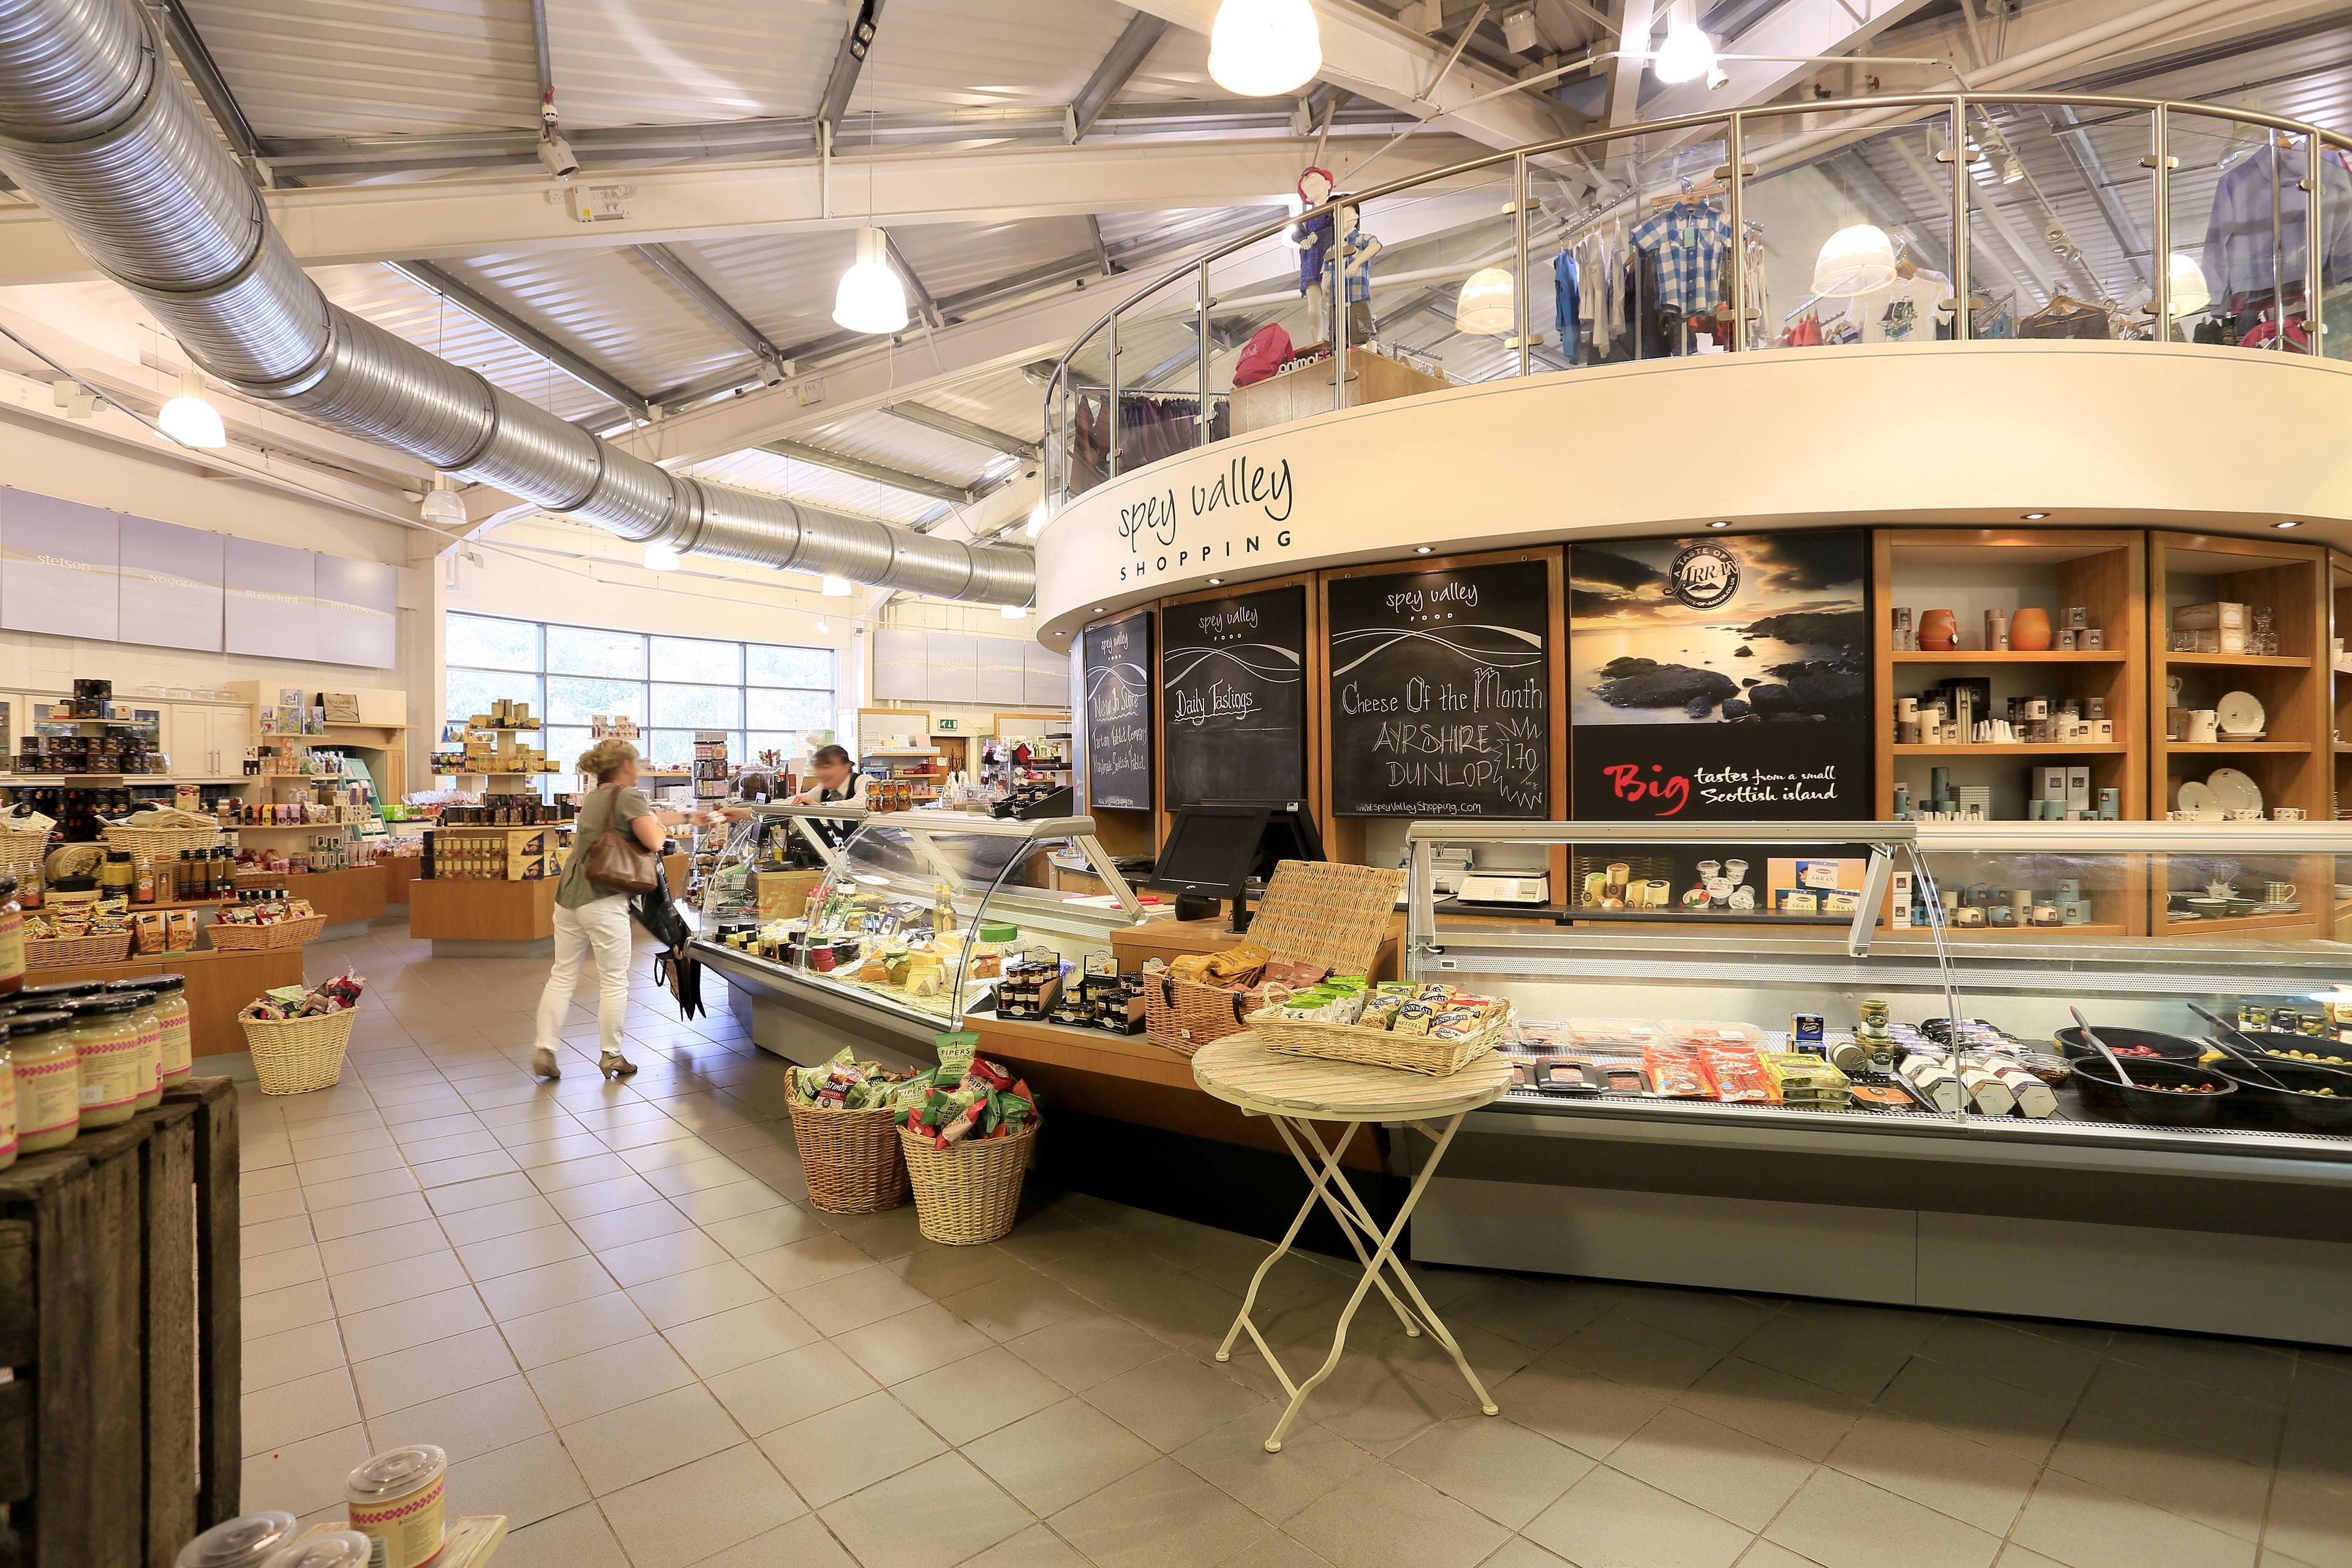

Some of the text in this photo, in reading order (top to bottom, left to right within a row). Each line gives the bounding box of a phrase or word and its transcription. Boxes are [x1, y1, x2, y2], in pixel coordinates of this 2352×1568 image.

[1278, 352, 1319, 374] animal
[1118, 456, 1292, 552] spey valley
[1120, 530, 1291, 581] SHOPPING
[1676, 548, 1709, 566] TASTE
[1713, 549, 1727, 560] OF
[1663, 560, 1740, 596] ARRAN
[1386, 582, 1478, 613] spey valley
[1198, 606, 1258, 634] spey valley
[1410, 612, 1453, 622] FOOD
[1101, 631, 1128, 655] spey valley
[1214, 633, 1242, 642] FOOD
[1093, 685, 1139, 718] New In Store
[1174, 678, 1253, 726] Daily Tastings
[1342, 666, 1543, 714] Cheese Of the Month
[1092, 726, 1110, 750] Tartan
[1110, 725, 1127, 747] Tablet
[1372, 721, 1493, 755] AYRSHIRE
[1128, 744, 1145, 772] Tablet
[1385, 760, 1493, 787] DUNLOP
[1694, 766, 1749, 785] tastes
[1752, 768, 1785, 785] from
[1801, 766, 1836, 780] small
[1603, 764, 1690, 816] Big
[1700, 782, 1838, 804] Scottish island
[941, 1047, 970, 1057] PIPERS
[899, 1083, 927, 1096] PIPERS
[940, 1101, 957, 1126] PIPERS
